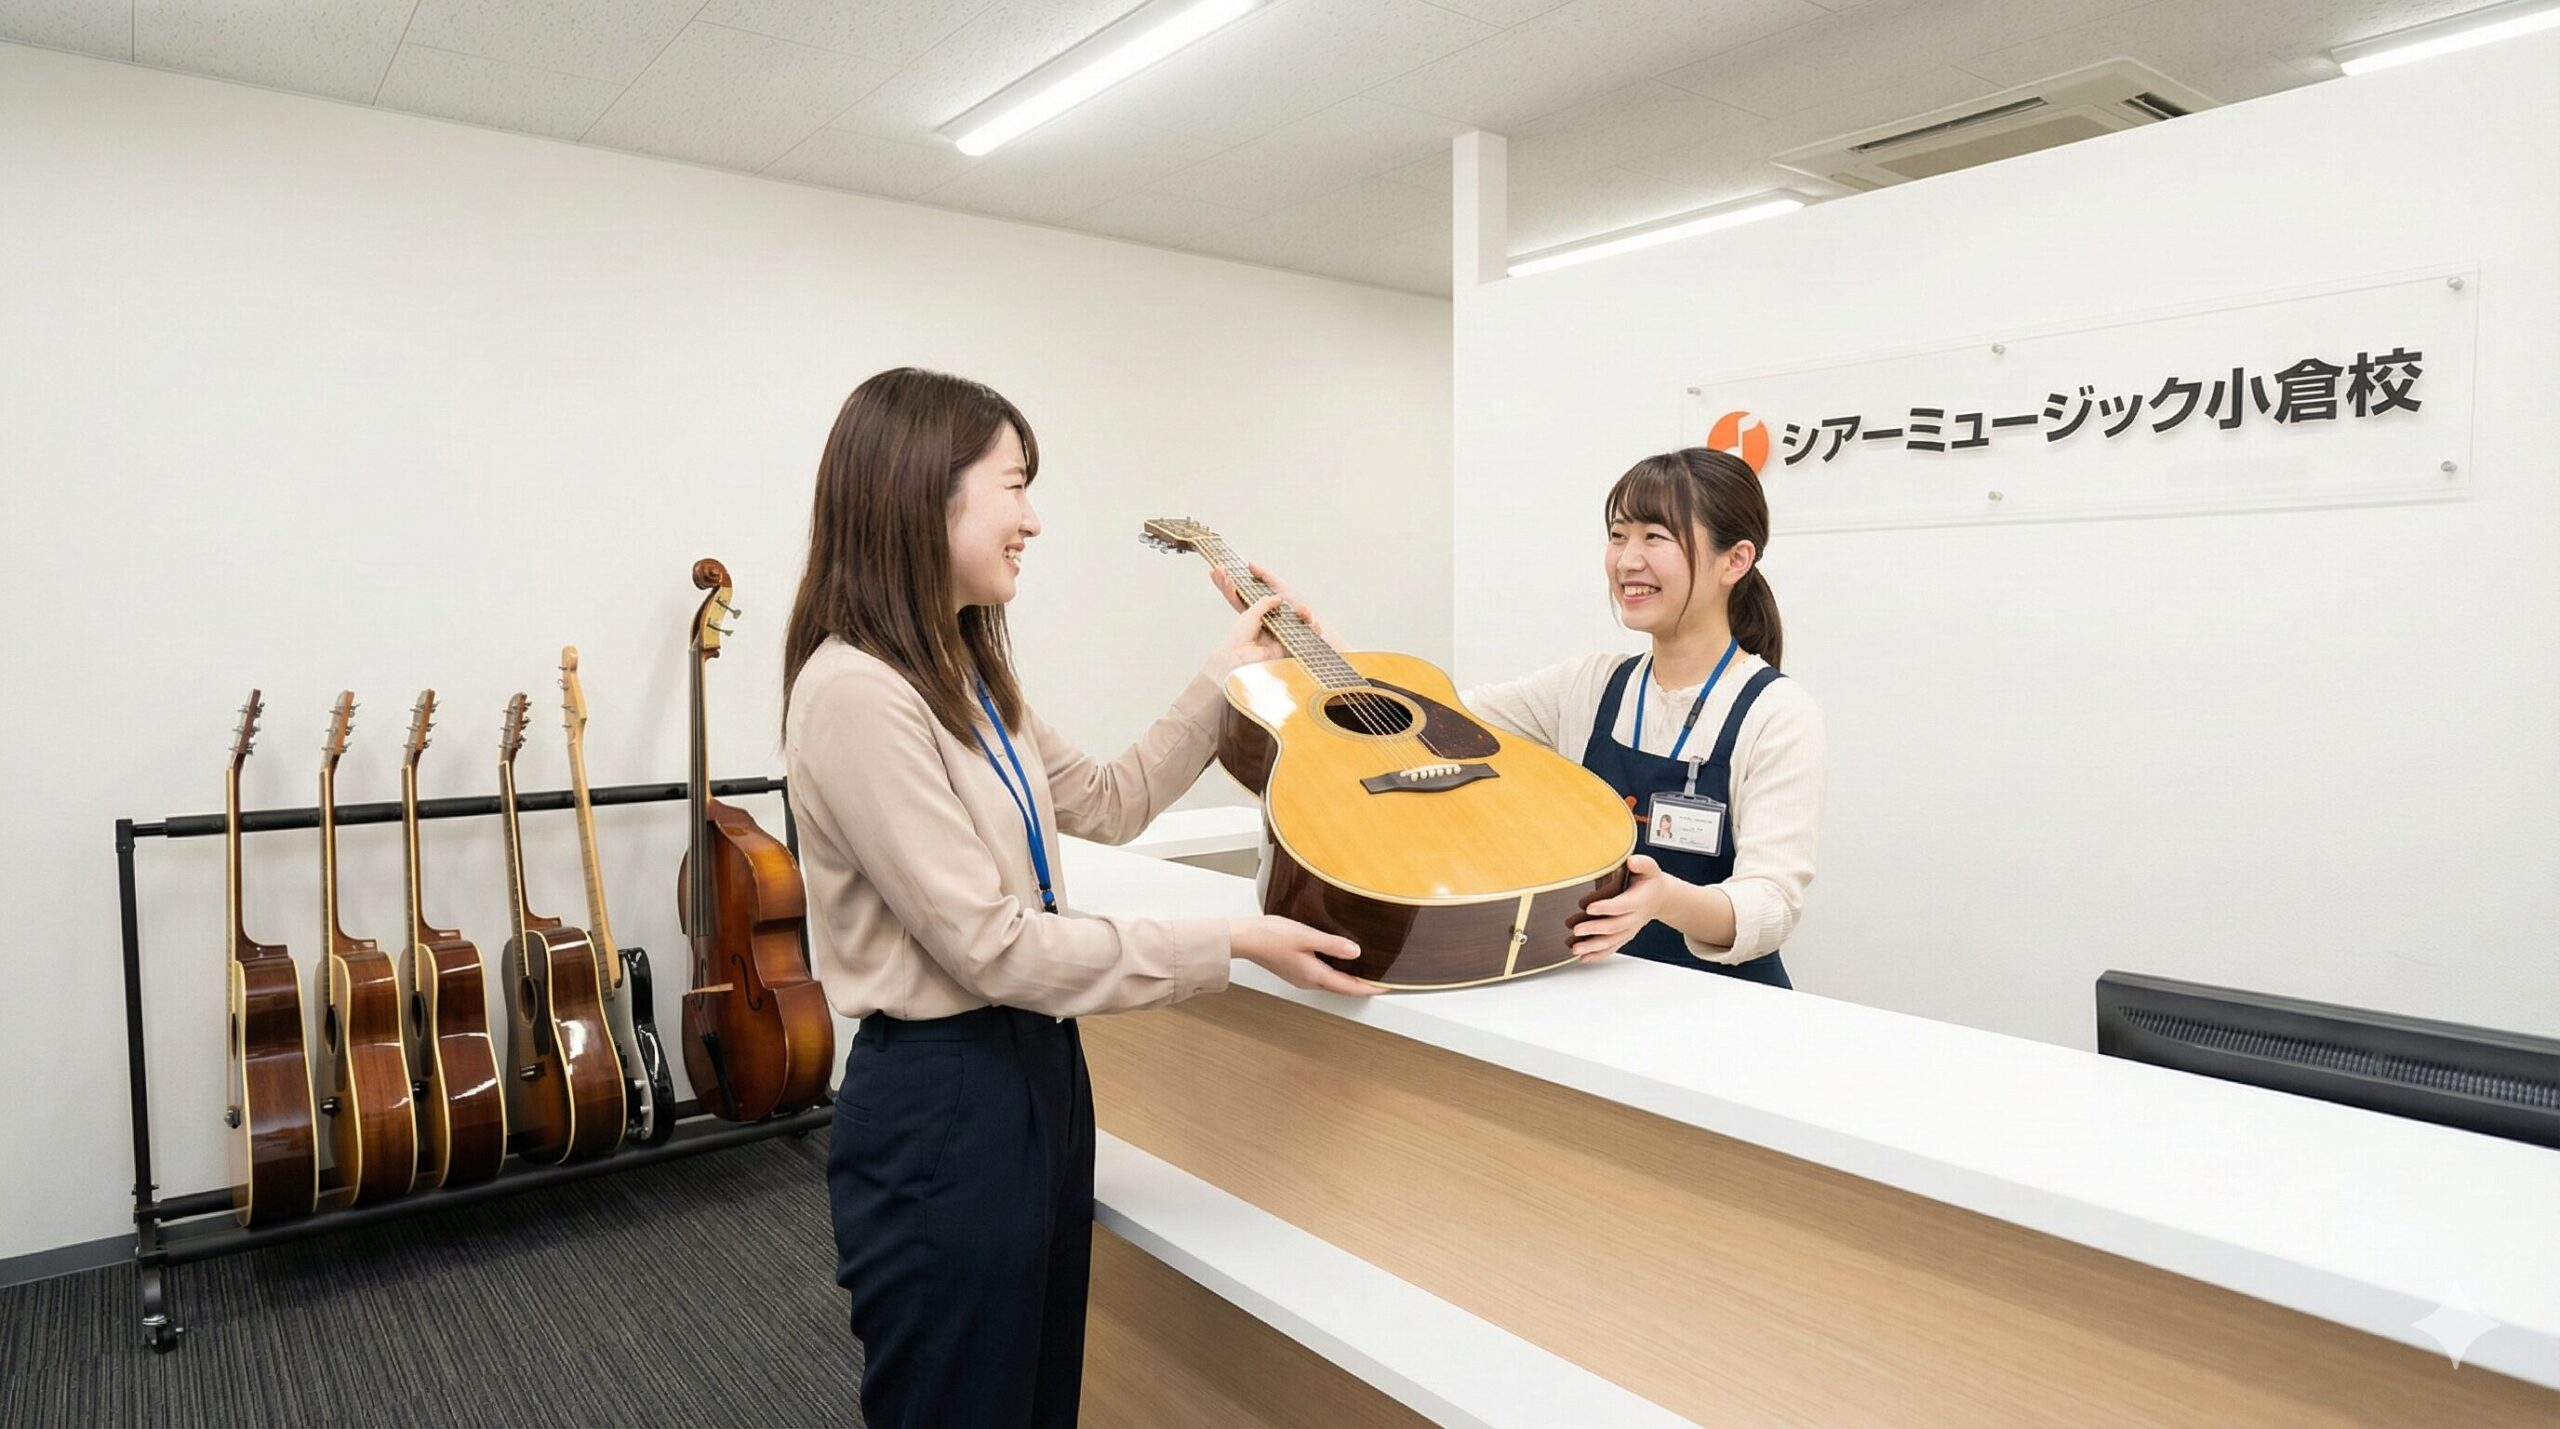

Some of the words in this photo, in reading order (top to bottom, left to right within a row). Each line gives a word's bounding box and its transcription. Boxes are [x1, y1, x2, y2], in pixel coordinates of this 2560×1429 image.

[1782, 347, 2423, 466] シアーミュージック小倉校
